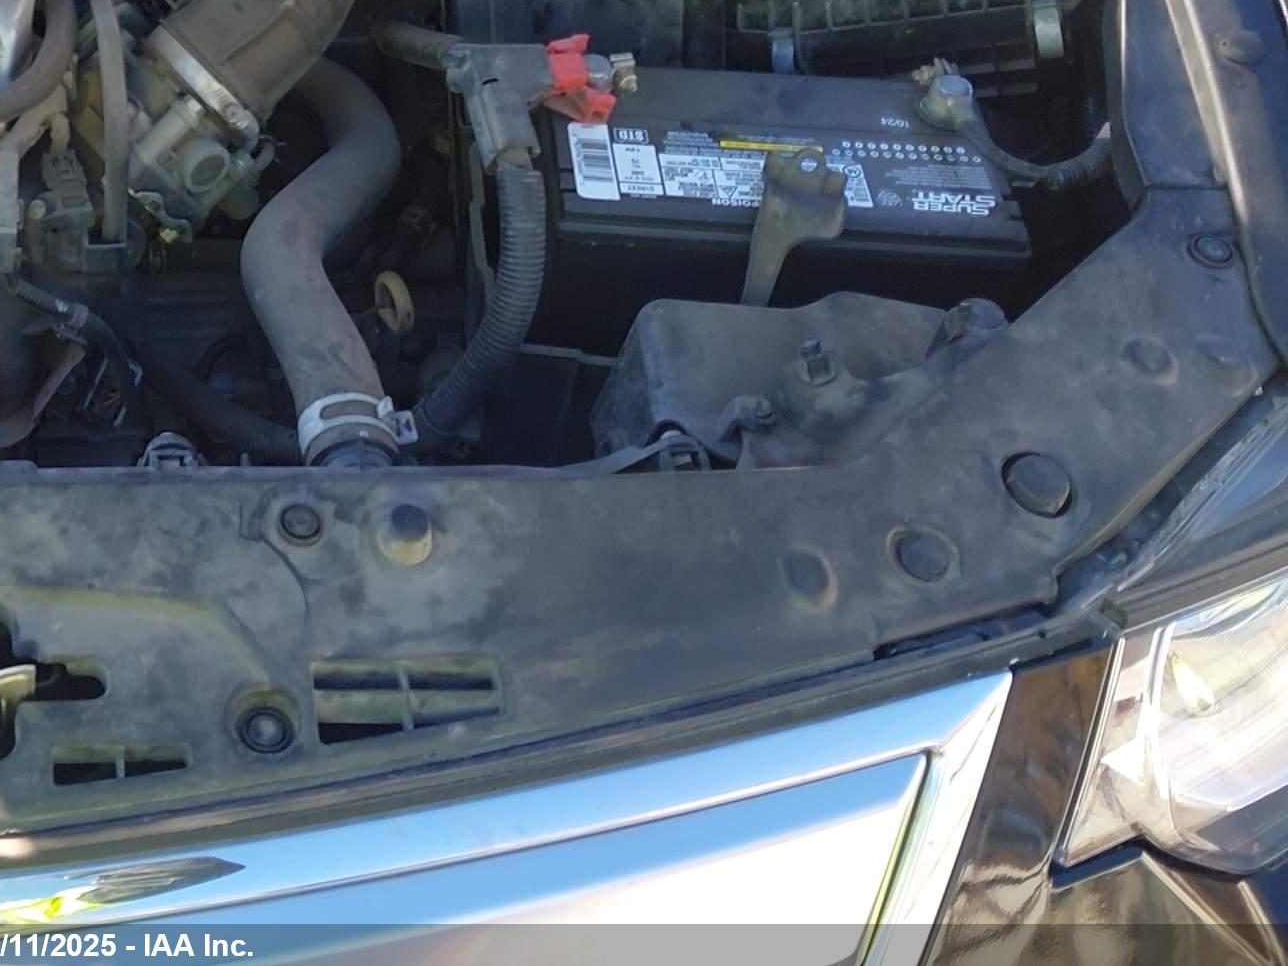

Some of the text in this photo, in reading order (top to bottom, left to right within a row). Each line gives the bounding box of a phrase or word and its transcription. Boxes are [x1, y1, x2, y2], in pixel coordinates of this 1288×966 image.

[712, 198, 760, 207] POISON
[912, 191, 996, 208] START
[913, 201, 990, 215] SUPER
